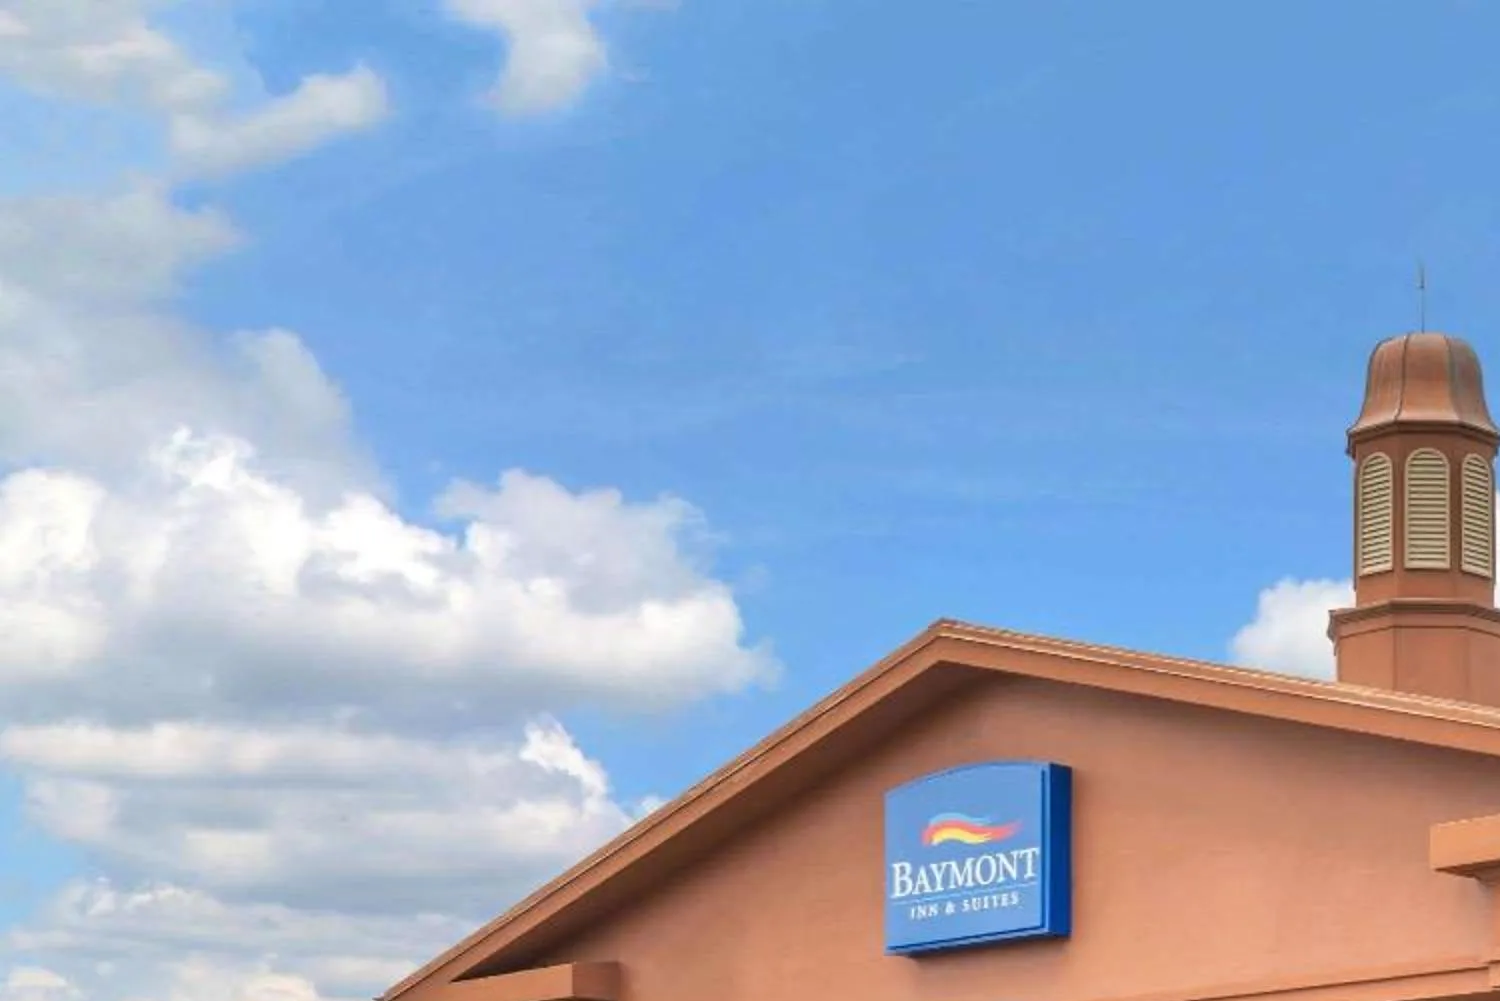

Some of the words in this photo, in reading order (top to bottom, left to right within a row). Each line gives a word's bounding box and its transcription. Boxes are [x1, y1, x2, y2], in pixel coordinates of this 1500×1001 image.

[891, 847, 1039, 899] BAYMONT
[910, 903, 939, 919] INN
[944, 901, 956, 915] &
[961, 891, 1020, 912] SUITES
